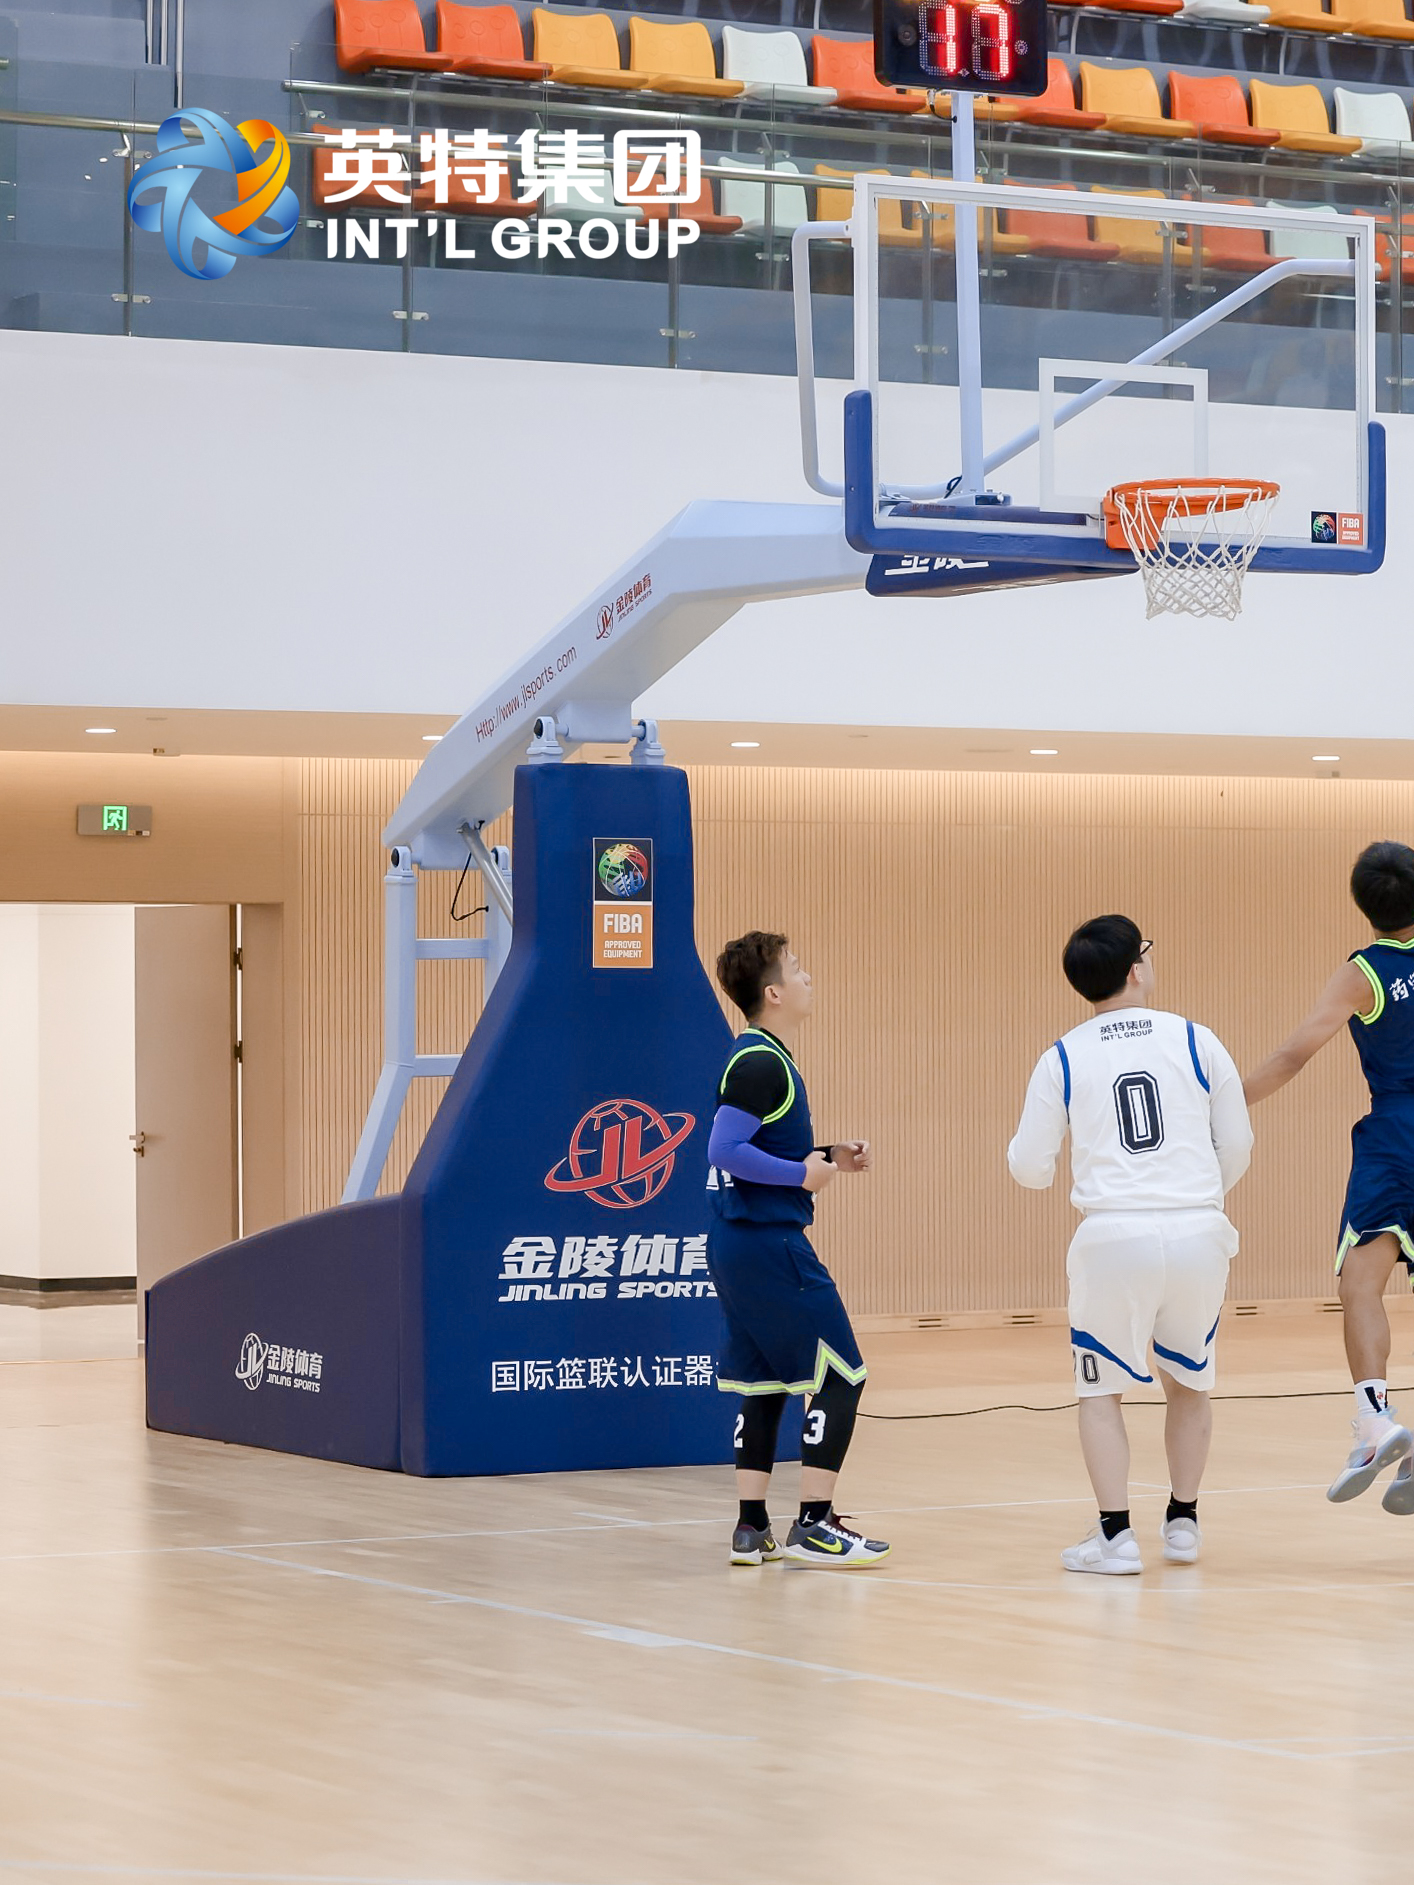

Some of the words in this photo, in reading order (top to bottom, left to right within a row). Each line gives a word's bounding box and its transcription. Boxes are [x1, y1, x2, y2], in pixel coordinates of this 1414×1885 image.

[944, 3, 1010, 78] 17
[1341, 517, 1360, 529] FIBA
[615, 573, 651, 616] 金陵体育
[603, 913, 643, 934] FIBA
[603, 950, 643, 959] EQUIPMENT
[604, 940, 641, 949] APPROVED
[1099, 1019, 1152, 1036] 英特集团
[1123, 1028, 1153, 1038] GROUP
[1112, 1070, 1165, 1155] 0
[498, 1283, 607, 1303] JINLING
[616, 1281, 719, 1299] SPORTS
[266, 1344, 323, 1380] 金陵体育
[266, 1373, 292, 1387] JINLING
[293, 1377, 321, 1393] SPORTS
[491, 1355, 718, 1393] 国际篮联认证器
[802, 1409, 827, 1445] 3
